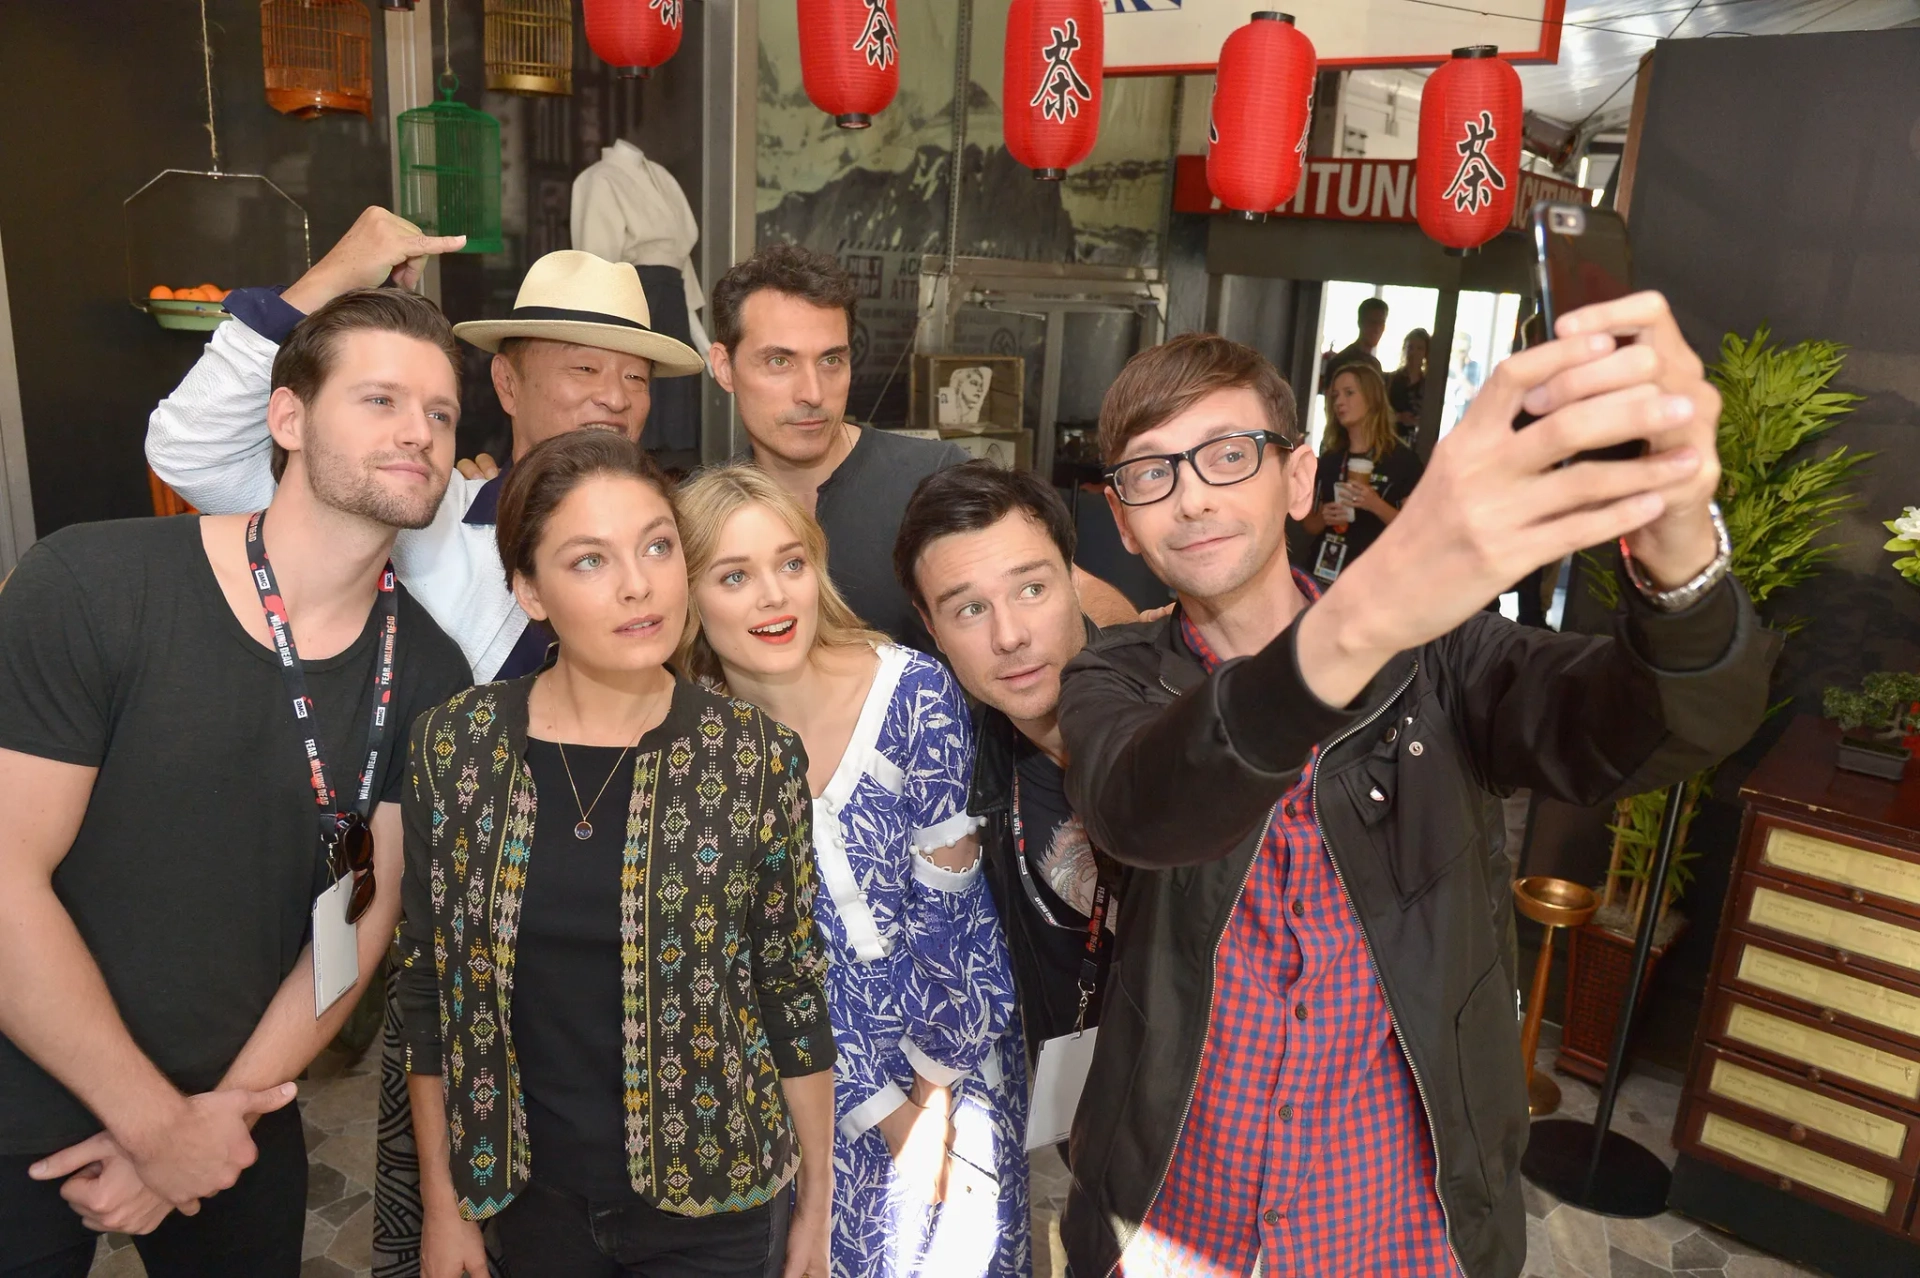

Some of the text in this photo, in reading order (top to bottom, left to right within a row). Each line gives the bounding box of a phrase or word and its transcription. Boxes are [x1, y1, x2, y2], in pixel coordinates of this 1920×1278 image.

[1030, 18, 1091, 124] 茶
[1442, 110, 1505, 215] 茶
[270, 614, 293, 667] WALKING DEAD
[381, 615, 396, 685] FEAR WALKING DEAD
[305, 738, 329, 806] FEAR WALKING DEAD
[359, 751, 378, 800] WALKING DEAD
